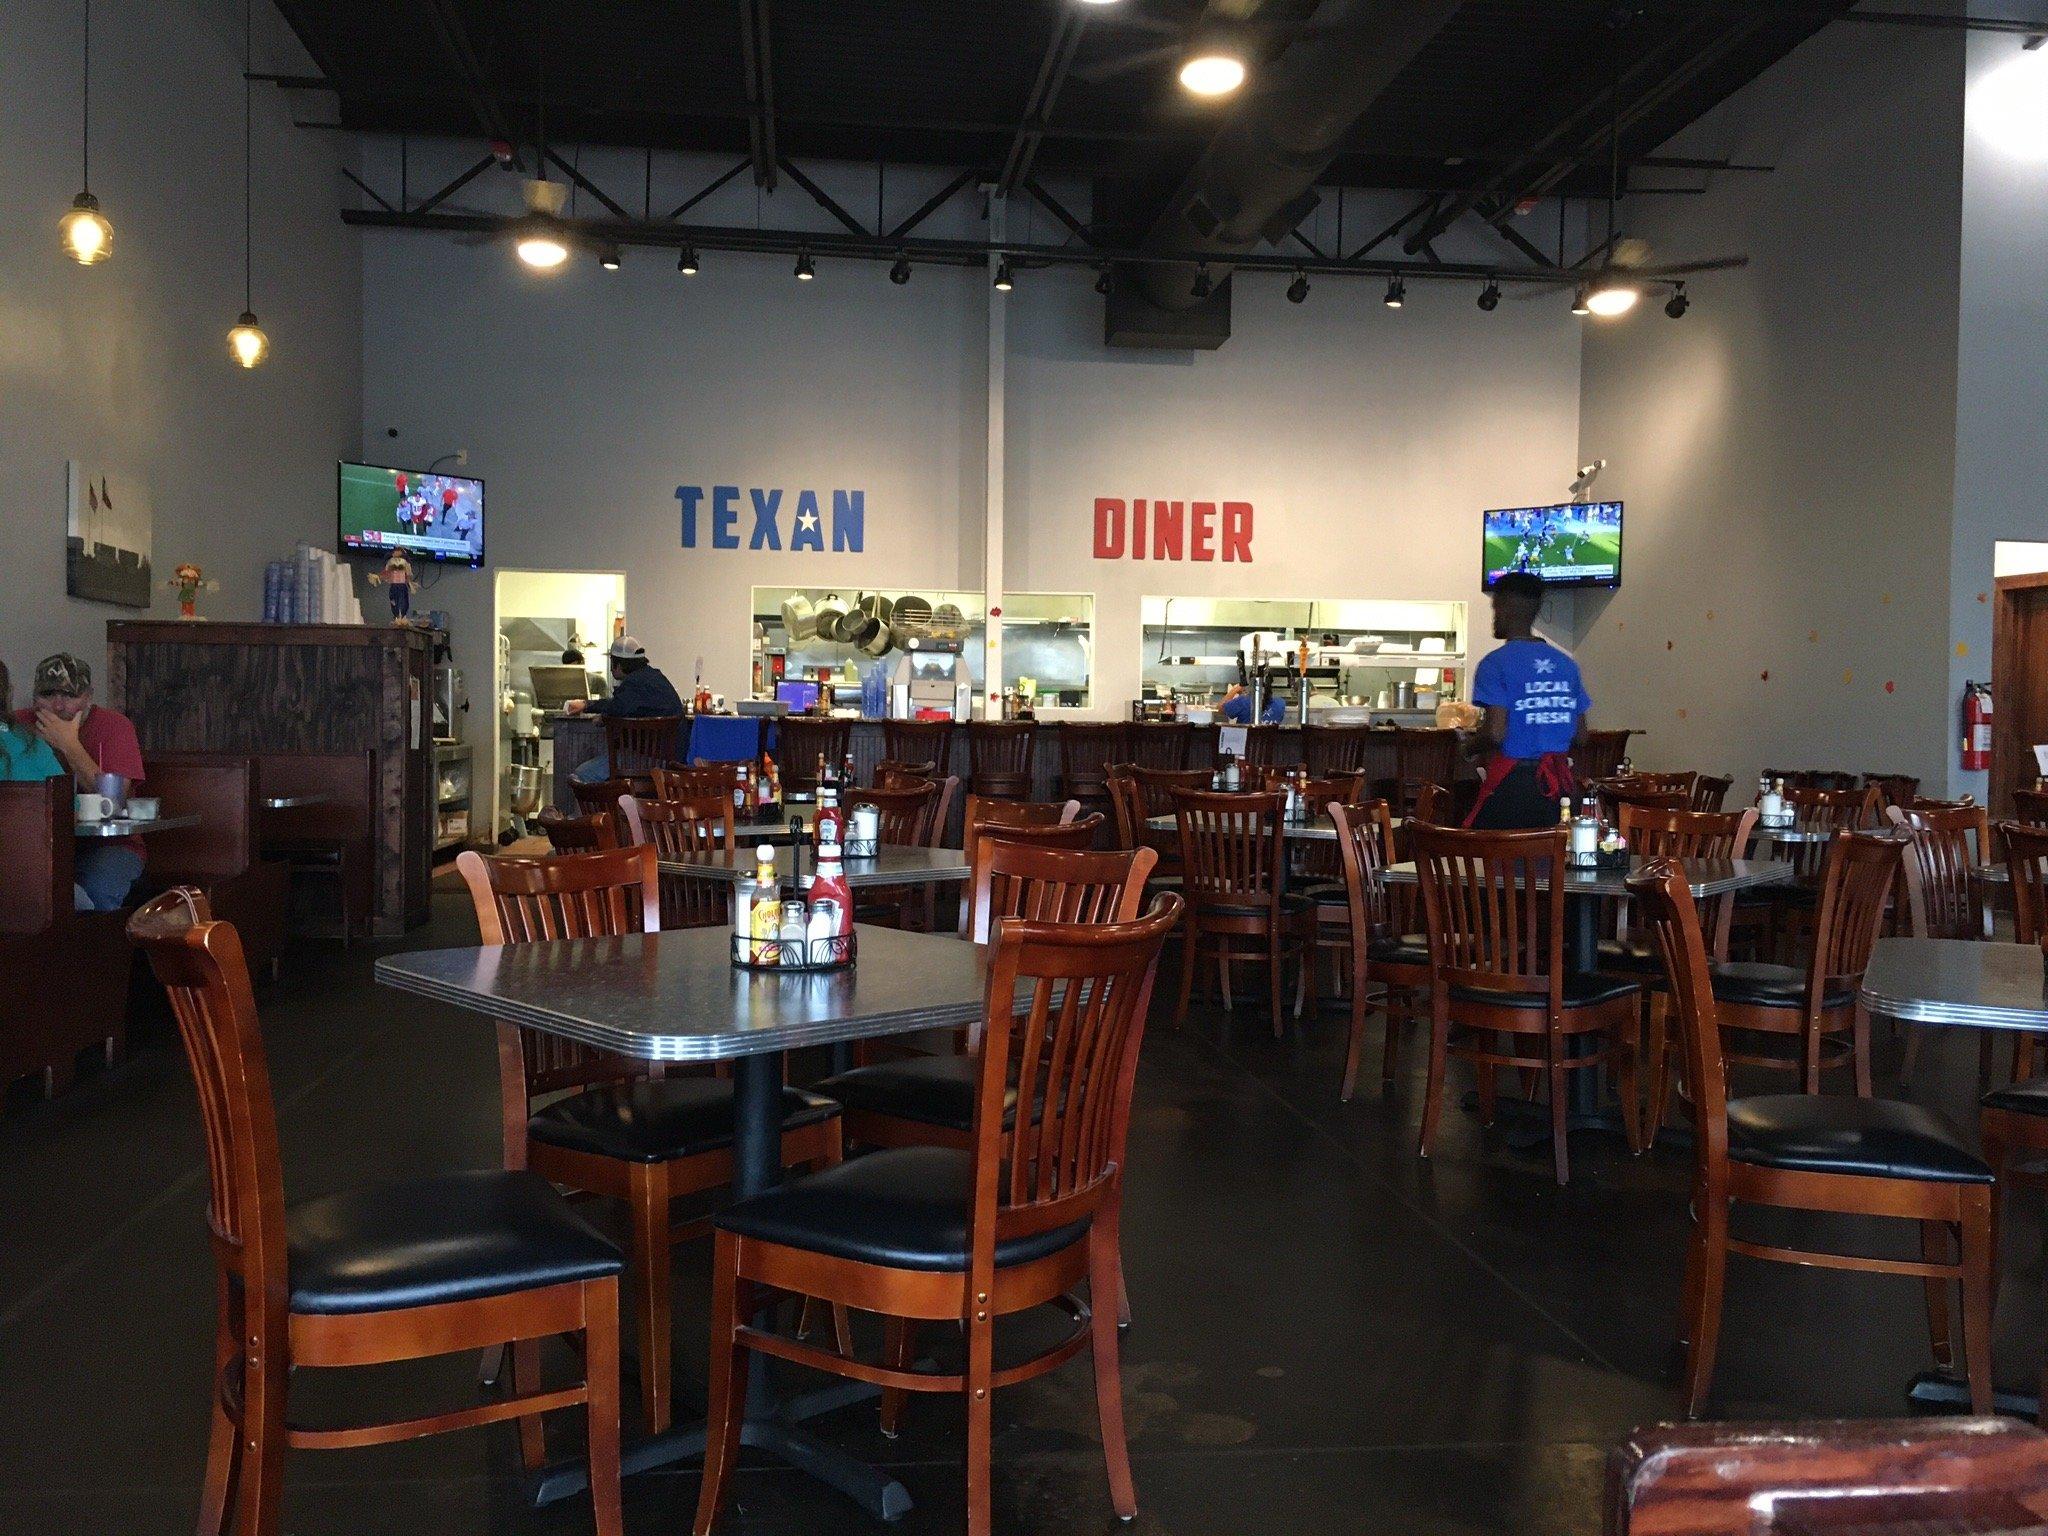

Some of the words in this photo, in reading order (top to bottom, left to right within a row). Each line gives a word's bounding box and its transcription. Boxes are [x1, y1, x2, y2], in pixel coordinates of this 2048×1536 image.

[674, 486, 865, 552] TEXAN
[1093, 498, 1253, 562] DINER
[1525, 681, 1571, 693] LOCAL
[1514, 696, 1578, 710] SCRATCH
[1526, 712, 1571, 724] FRESH
